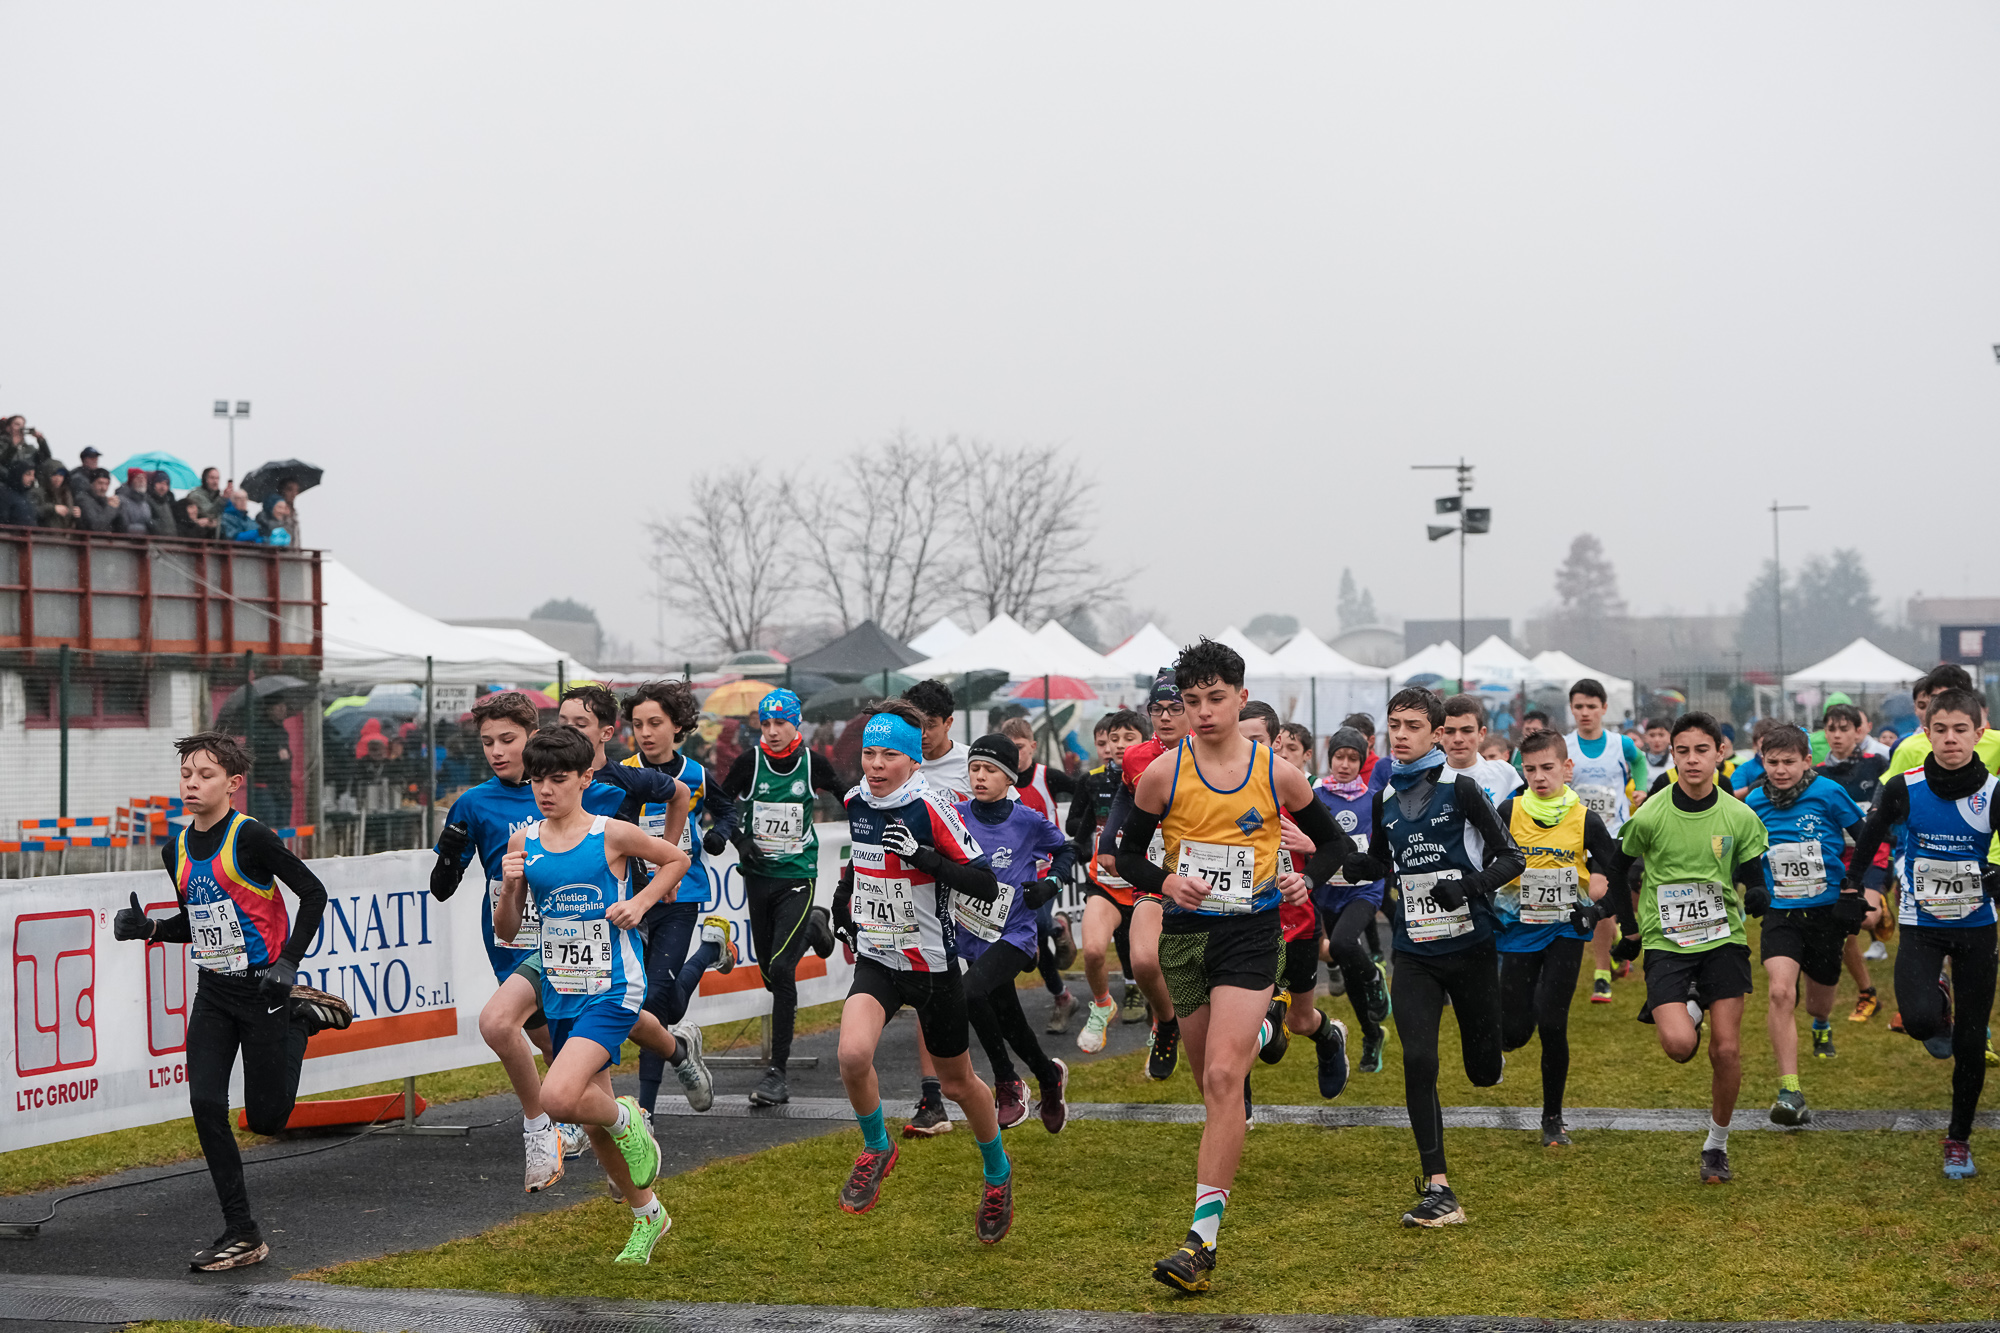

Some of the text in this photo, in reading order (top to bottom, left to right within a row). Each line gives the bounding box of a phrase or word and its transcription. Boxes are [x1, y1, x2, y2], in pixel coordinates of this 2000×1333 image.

[865, 725, 892, 733] RODE
[1585, 798, 1605, 811] 763
[765, 820, 789, 834] 774
[1408, 833, 1424, 843] CUS
[1930, 834, 1954, 842] PATRIA
[1402, 843, 1447, 863] PRO PATRIA
[1406, 853, 1441, 867] MILANO
[1781, 862, 1810, 877] 738
[1198, 868, 1232, 891] 775
[1932, 879, 1963, 895] 770
[555, 893, 588, 902] Atletica
[1537, 887, 1562, 902] 731
[1672, 888, 1693, 898] CAP
[523, 903, 540, 923] 43
[556, 902, 605, 913] Meneghina
[867, 901, 895, 922] 741
[965, 895, 993, 917] 748
[1416, 896, 1445, 915] 18
[1676, 900, 1709, 922] 745
[198, 927, 222, 946] 737
[555, 928, 577, 937] CAP
[558, 945, 593, 965] 754
[254, 967, 271, 978] NIK
[415, 981, 455, 1008] S.r.l.
[149, 1066, 171, 1089] LTC
[16, 1078, 99, 1112] LTC GROUP
